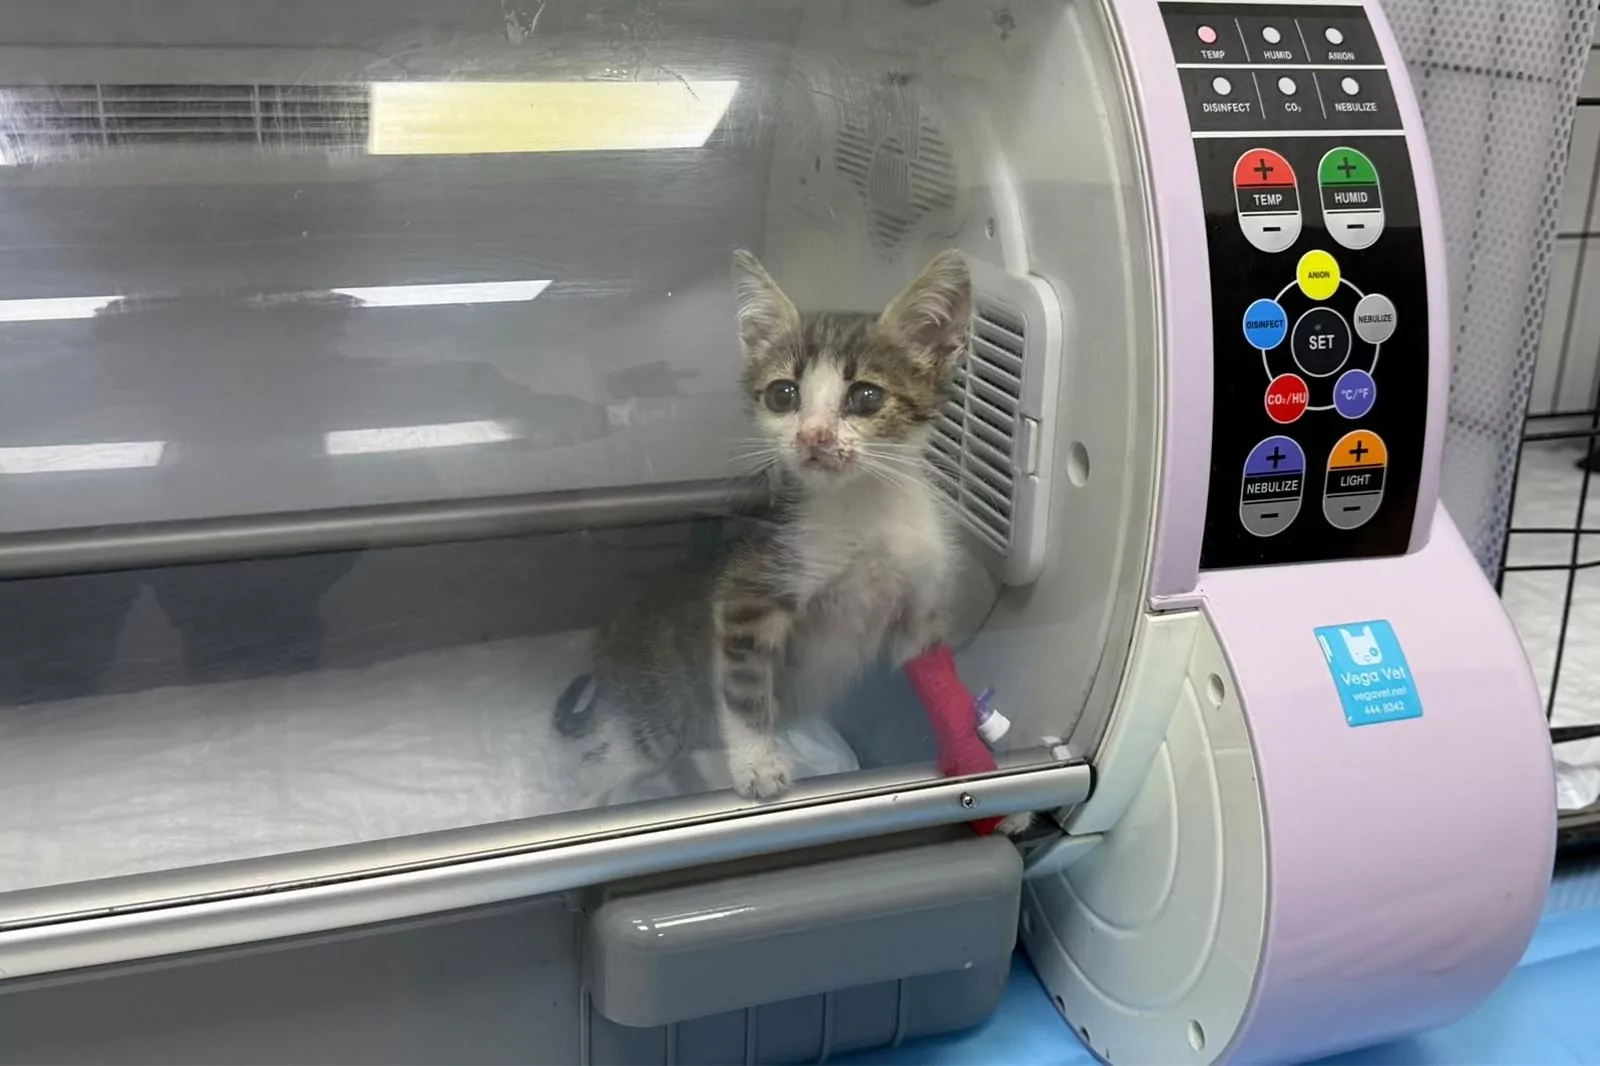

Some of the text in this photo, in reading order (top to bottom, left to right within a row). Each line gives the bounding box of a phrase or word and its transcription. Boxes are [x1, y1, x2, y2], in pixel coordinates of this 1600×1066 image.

[1201, 50, 1225, 60] TEMP
[1264, 51, 1292, 60] HUMID
[1328, 51, 1355, 61] ANION
[1203, 103, 1251, 113] DISINFECT
[1335, 103, 1377, 112] NEBULIZE
[1253, 194, 1283, 206] TEMP
[1335, 192, 1368, 204] HUMID
[1307, 271, 1330, 279] ANION
[1358, 314, 1392, 323] NEBULIZE
[1247, 320, 1284, 329] DISINFECT
[1309, 334, 1335, 350] SET
[1340, 474, 1371, 487] LIGHT
[1247, 480, 1299, 494] NEBULIZE
[1340, 666, 1406, 686] Vega Vet
